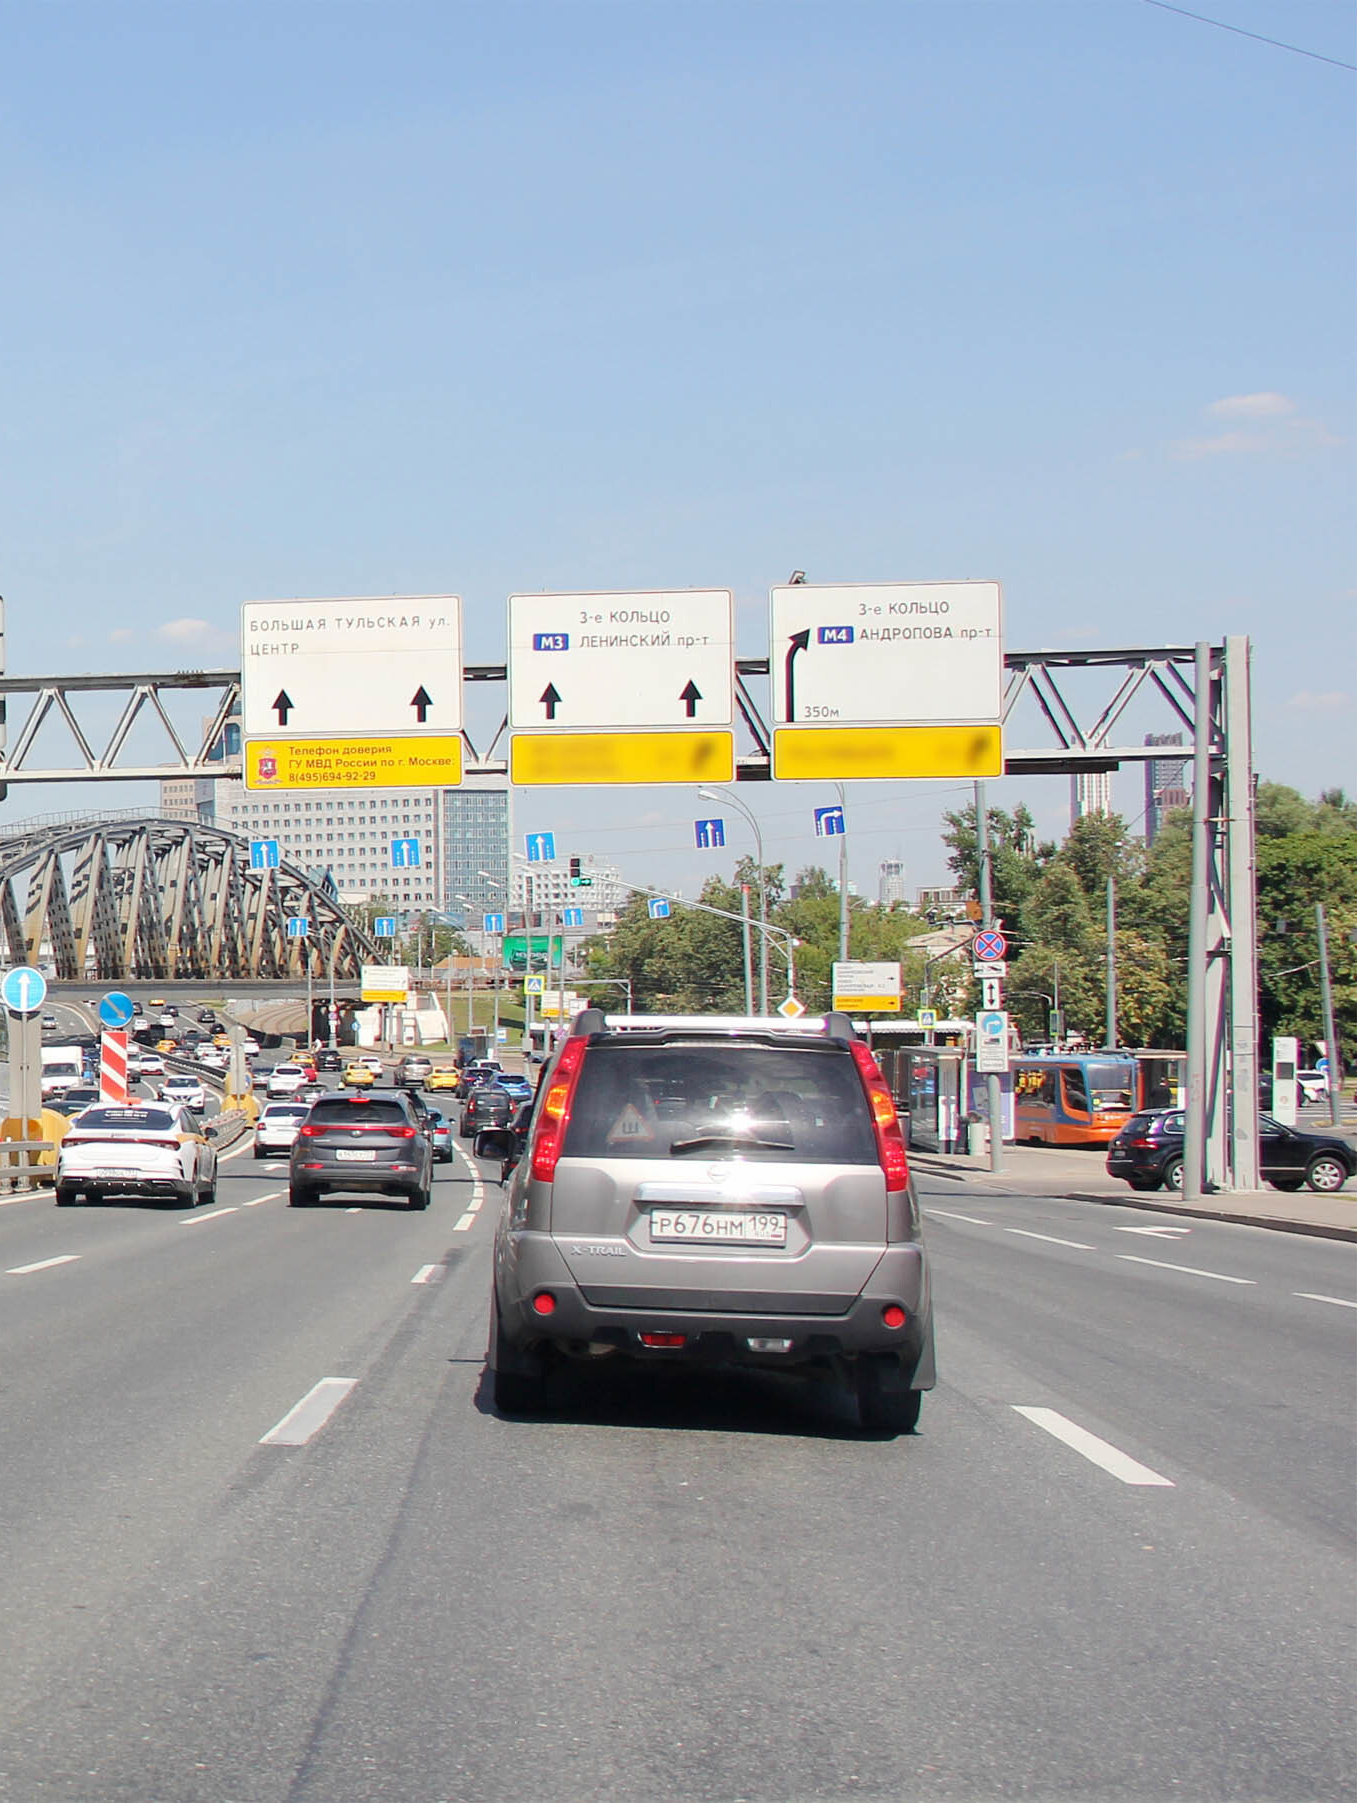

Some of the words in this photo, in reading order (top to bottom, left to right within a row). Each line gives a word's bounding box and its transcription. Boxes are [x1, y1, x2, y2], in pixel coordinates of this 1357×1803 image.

[859, 603, 882, 616] 3-е
[889, 601, 949, 616] КОЛЬЦО
[250, 618, 327, 632] БОЛЬШАЯ
[335, 616, 421, 630] ТУЛЬСКАЯ
[428, 617, 451, 630] ул.
[580, 611, 602, 624] 3-е
[610, 610, 670, 624] КОЛЬЦО
[579, 631, 671, 648] ЛЕНИНСКИЙ
[677, 635, 710, 649] пр-т
[823, 628, 848, 642] М4
[860, 626, 954, 641] АНДРОПОВА
[960, 627, 993, 641] пр-т
[250, 643, 300, 657] ЦЕНТР
[540, 636, 564, 650] М3
[804, 706, 840, 718] 350м
[288, 746, 340, 757] Телефон
[342, 745, 393, 756] доверия
[288, 760, 302, 770] ГУ
[305, 759, 332, 770] МВД
[336, 758, 378, 769] России
[381, 759, 395, 768] по
[288, 771, 377, 783] 8(495)694-92-29
[659, 1214, 744, 1236] Р676НМ
[749, 1216, 779, 1232] 199
[571, 1245, 627, 1257] X-TRAIL
